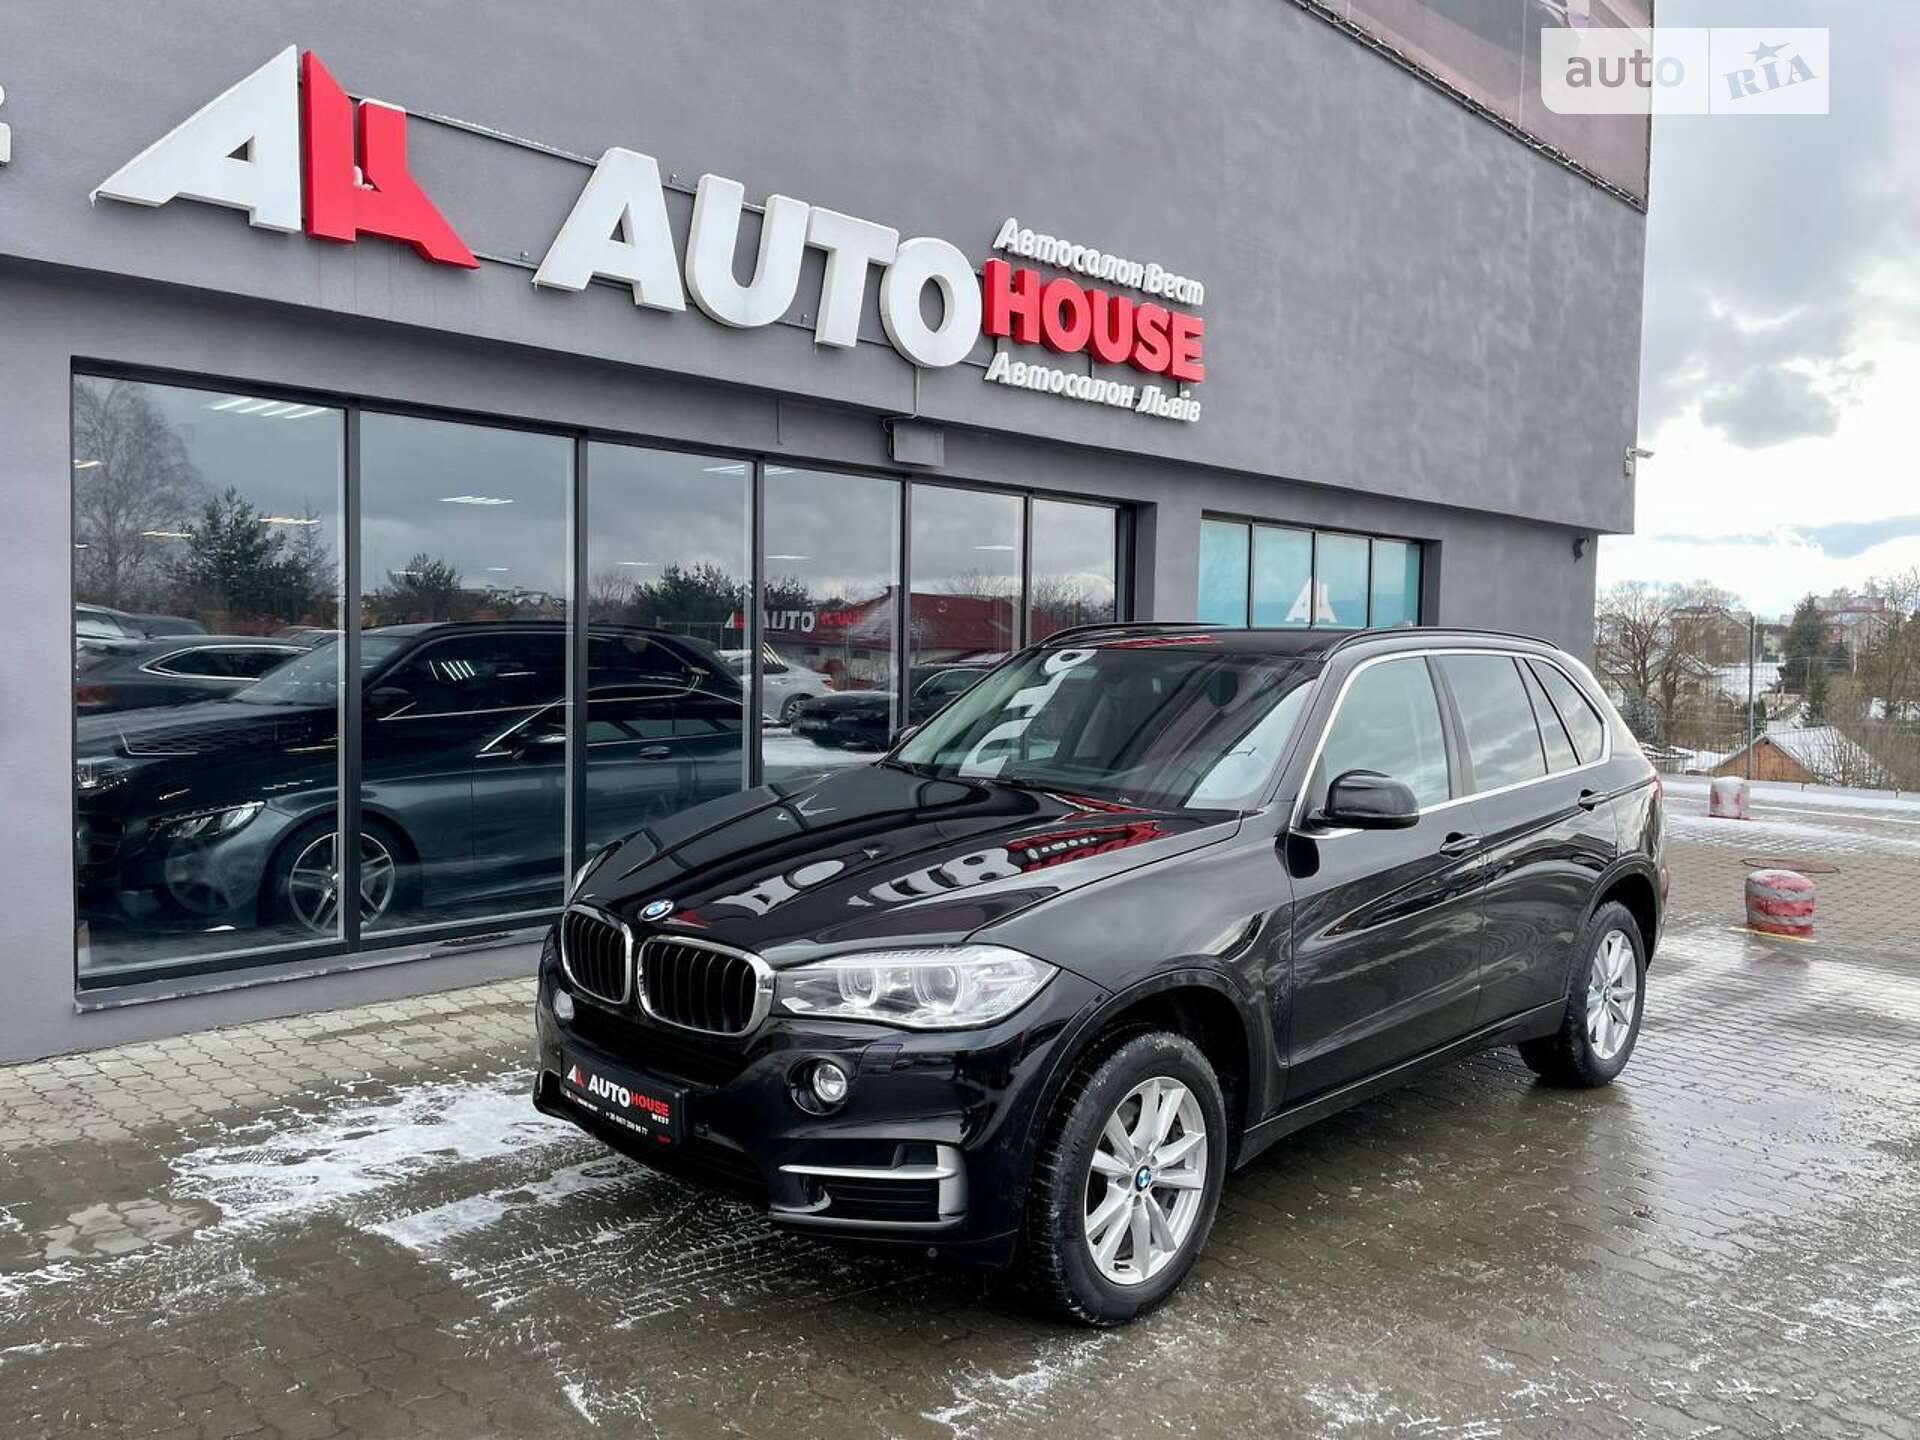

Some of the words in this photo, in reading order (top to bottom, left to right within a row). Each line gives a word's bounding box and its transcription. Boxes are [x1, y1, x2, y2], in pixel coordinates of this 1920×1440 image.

[992, 217, 1144, 289] Автосалон
[1142, 262, 1205, 306] Вест
[984, 350, 1136, 410] Автосалон
[1135, 384, 1201, 423] Львів
[651, 1112, 670, 1125] WEST
